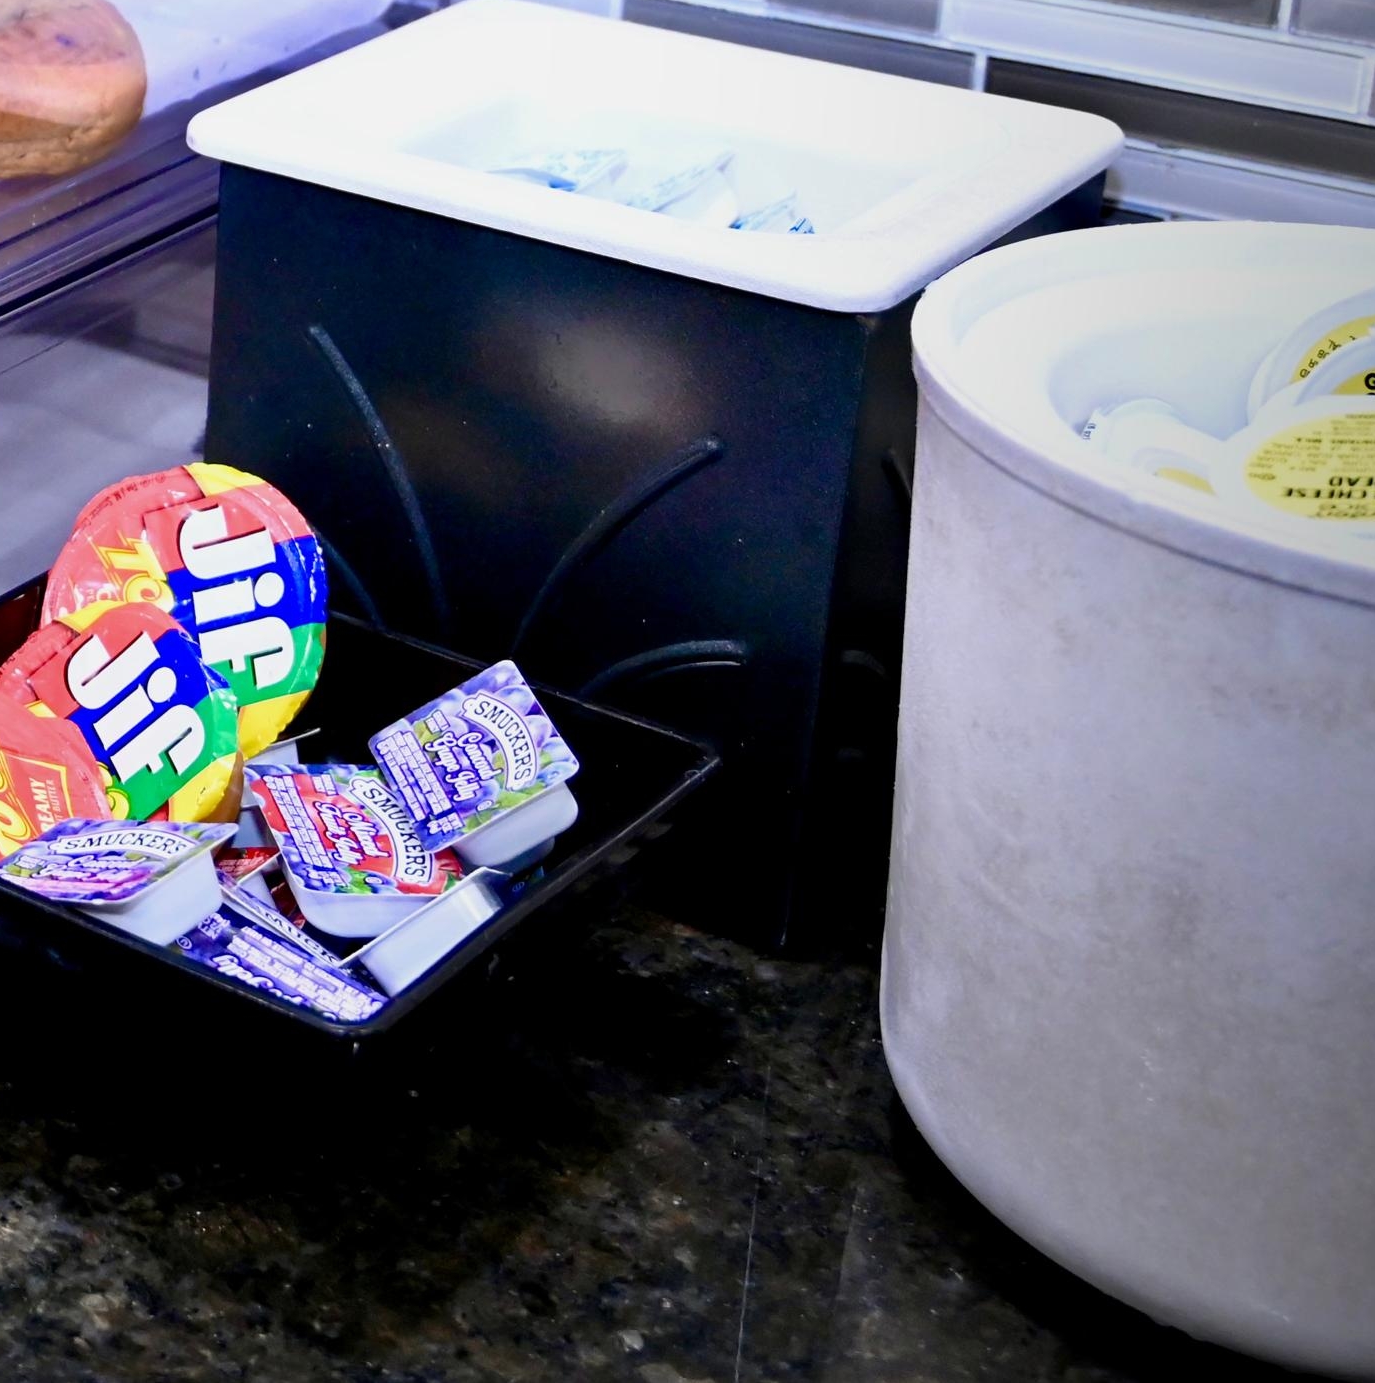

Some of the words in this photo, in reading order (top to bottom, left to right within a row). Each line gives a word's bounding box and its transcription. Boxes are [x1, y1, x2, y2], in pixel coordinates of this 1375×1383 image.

[178, 503, 296, 691] Jif
[67, 629, 206, 785] Jif
[474, 700, 535, 781] SMUCKER'S
[457, 732, 502, 781] Concord
[28, 777, 53, 832] REAMY
[64, 832, 188, 855] SMUCKER'S
[362, 787, 426, 878] SMUCKER'S
